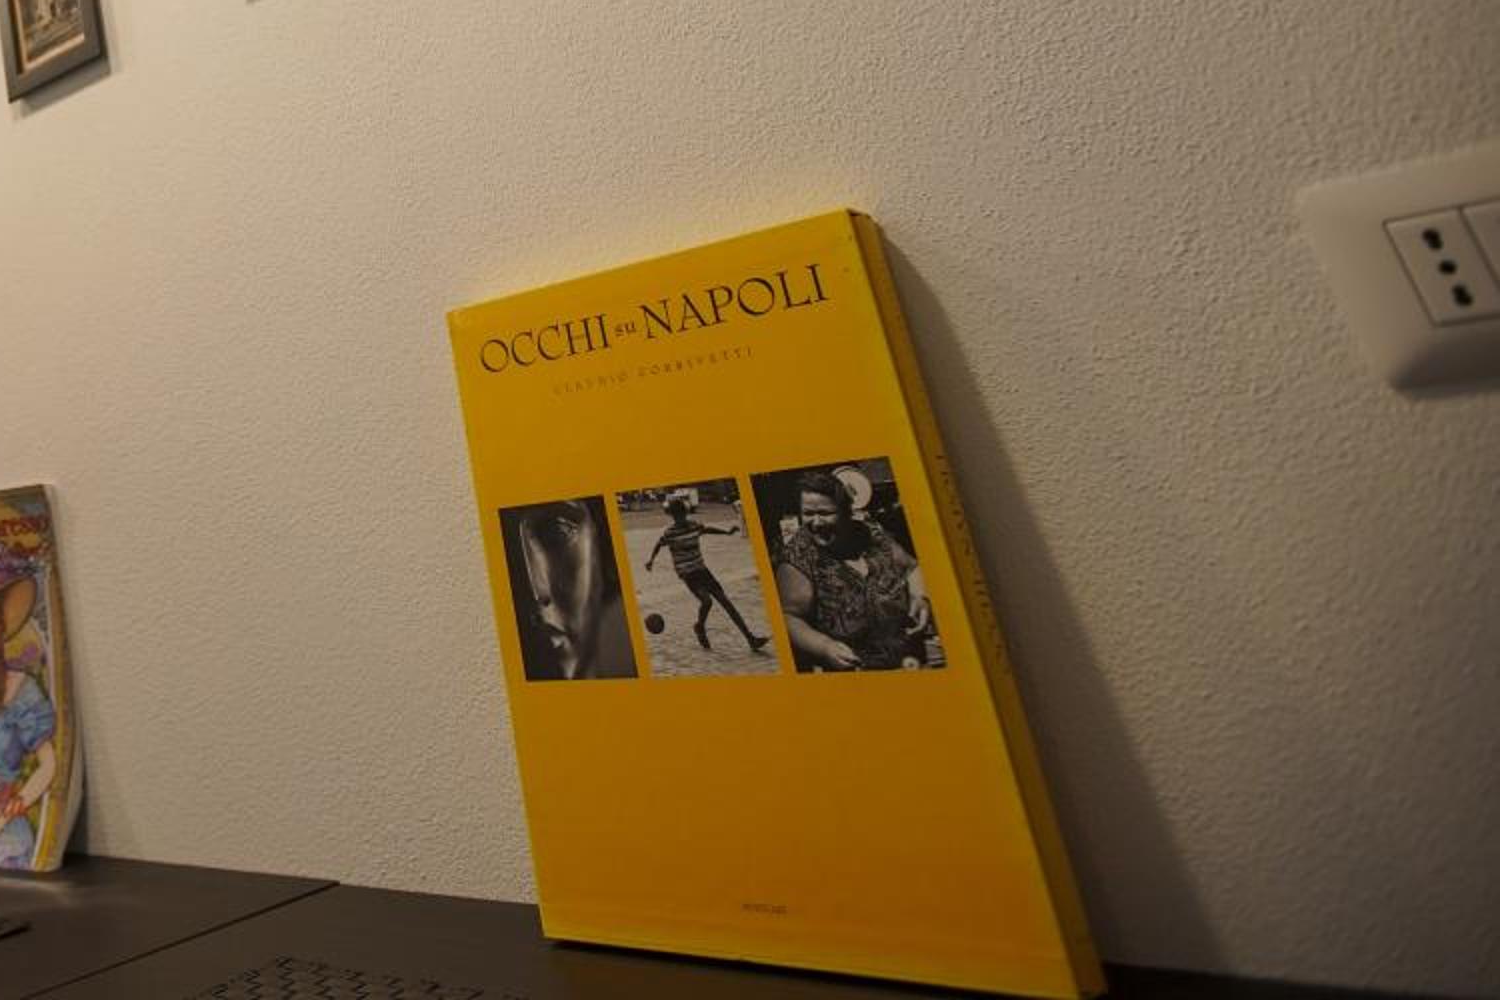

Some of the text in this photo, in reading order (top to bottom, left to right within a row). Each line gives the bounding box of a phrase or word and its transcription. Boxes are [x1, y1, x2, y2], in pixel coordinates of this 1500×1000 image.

[479, 263, 831, 374] OCCHI su NAPOLI
